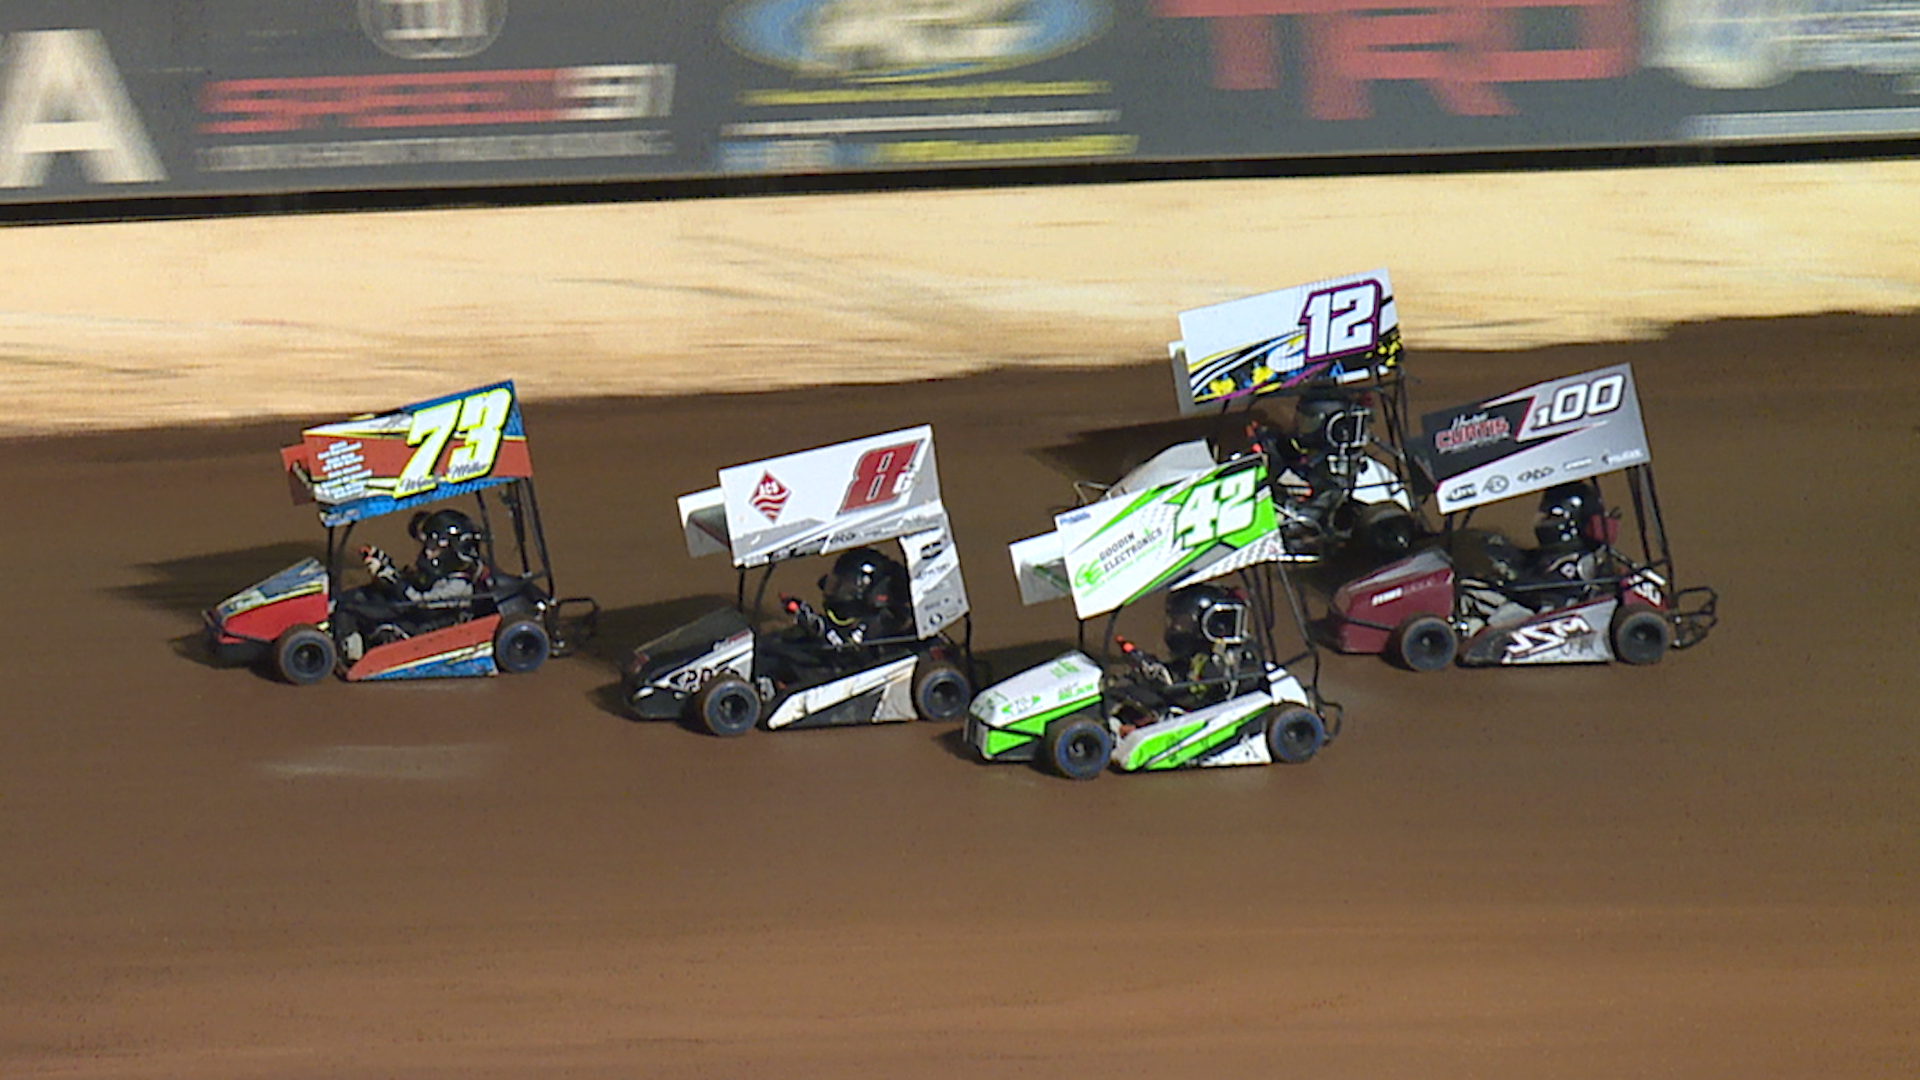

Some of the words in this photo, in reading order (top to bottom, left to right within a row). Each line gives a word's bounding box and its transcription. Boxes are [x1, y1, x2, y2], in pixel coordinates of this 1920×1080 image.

[1304, 280, 1380, 361] 12
[1435, 416, 1510, 449] CURTIS
[1531, 372, 1626, 431] 100
[394, 387, 512, 499] 73
[1174, 465, 1258, 550] 42
[1103, 527, 1163, 573] ELECTRONICS
